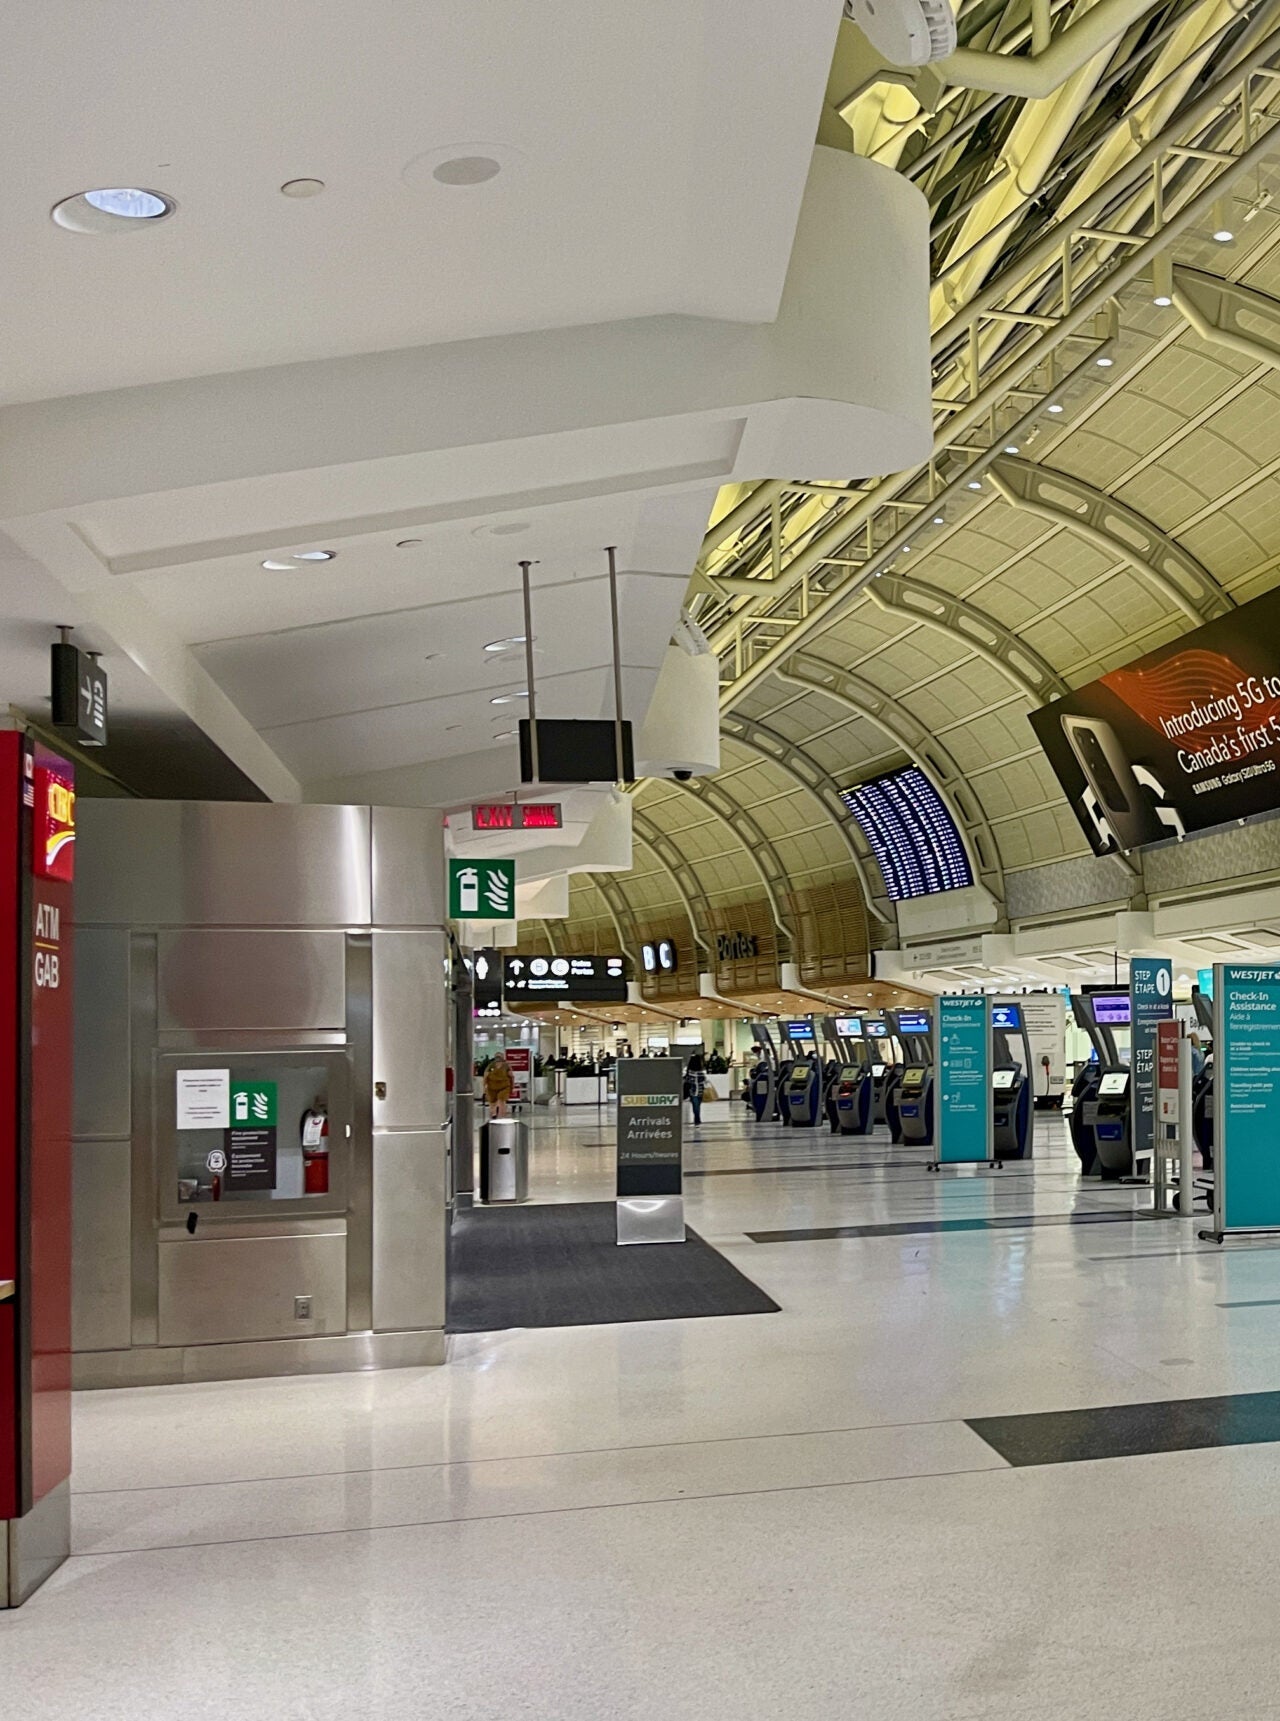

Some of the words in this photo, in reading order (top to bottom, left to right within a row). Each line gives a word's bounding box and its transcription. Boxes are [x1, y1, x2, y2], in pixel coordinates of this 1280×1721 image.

[1160, 694, 1243, 740] Introducing
[1236, 677, 1265, 709] 5G
[1177, 734, 1241, 774] Canada's
[1237, 724, 1274, 753] first
[476, 806, 513, 828] EXIT
[36, 903, 60, 940] ATM
[643, 945, 656, 970] B
[659, 942, 672, 969] C
[35, 952, 59, 989] GAB
[1135, 970, 1151, 981] STEP
[1230, 970, 1275, 982] WESTJET
[1135, 982, 1156, 994] ÉTAPE
[1230, 992, 1269, 1001] Check-In
[942, 999, 974, 1008] WESTJET
[1229, 1002, 1277, 1011] Assistance
[1136, 1050, 1153, 1060] STEP
[1136, 1061, 1154, 1073] ÉTAP
[623, 1095, 678, 1106] SUBWAY
[628, 1116, 672, 1126] Arrivals
[627, 1129, 673, 1139] Arrivées
